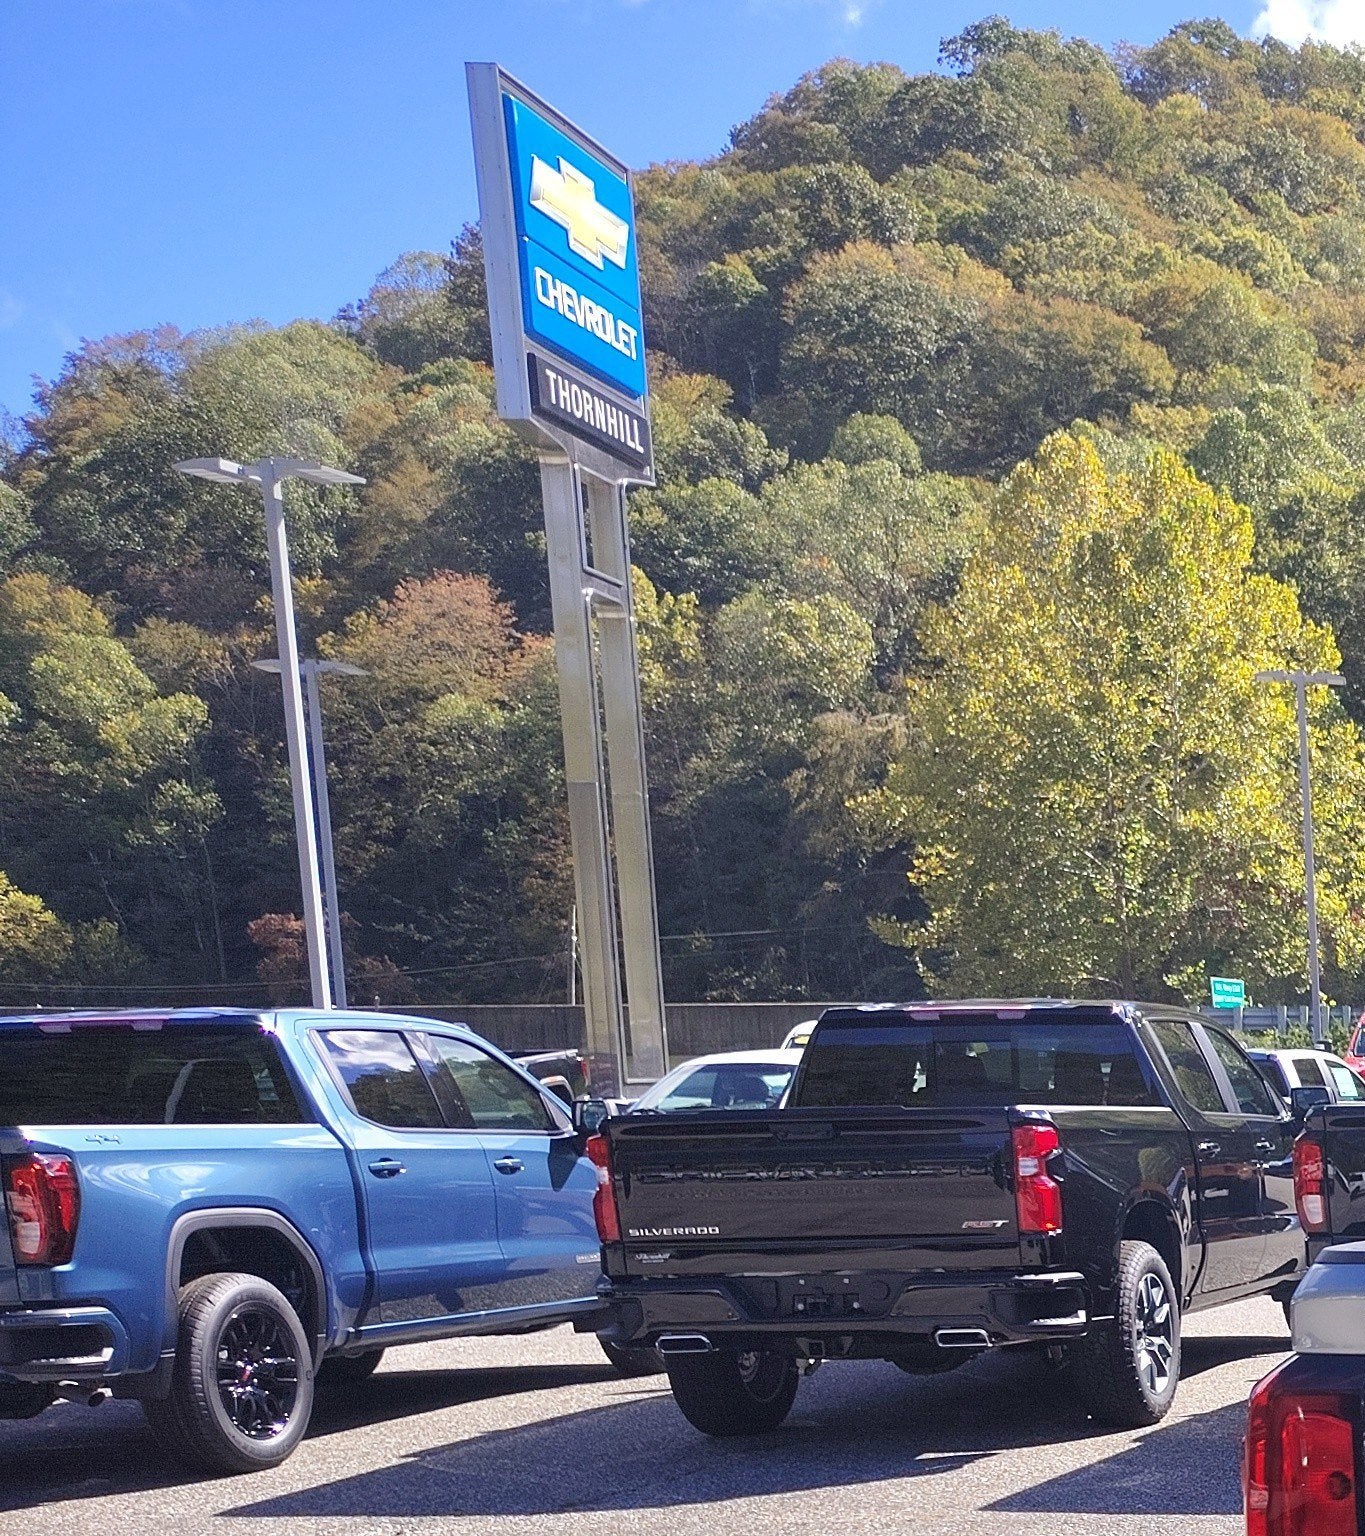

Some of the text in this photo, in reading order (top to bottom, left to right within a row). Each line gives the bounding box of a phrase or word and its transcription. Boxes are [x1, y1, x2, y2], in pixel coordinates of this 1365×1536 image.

[533, 266, 638, 360] CHEVROLET
[545, 368, 644, 453] THORNHILL
[628, 1226, 720, 1237] SILVERADO
